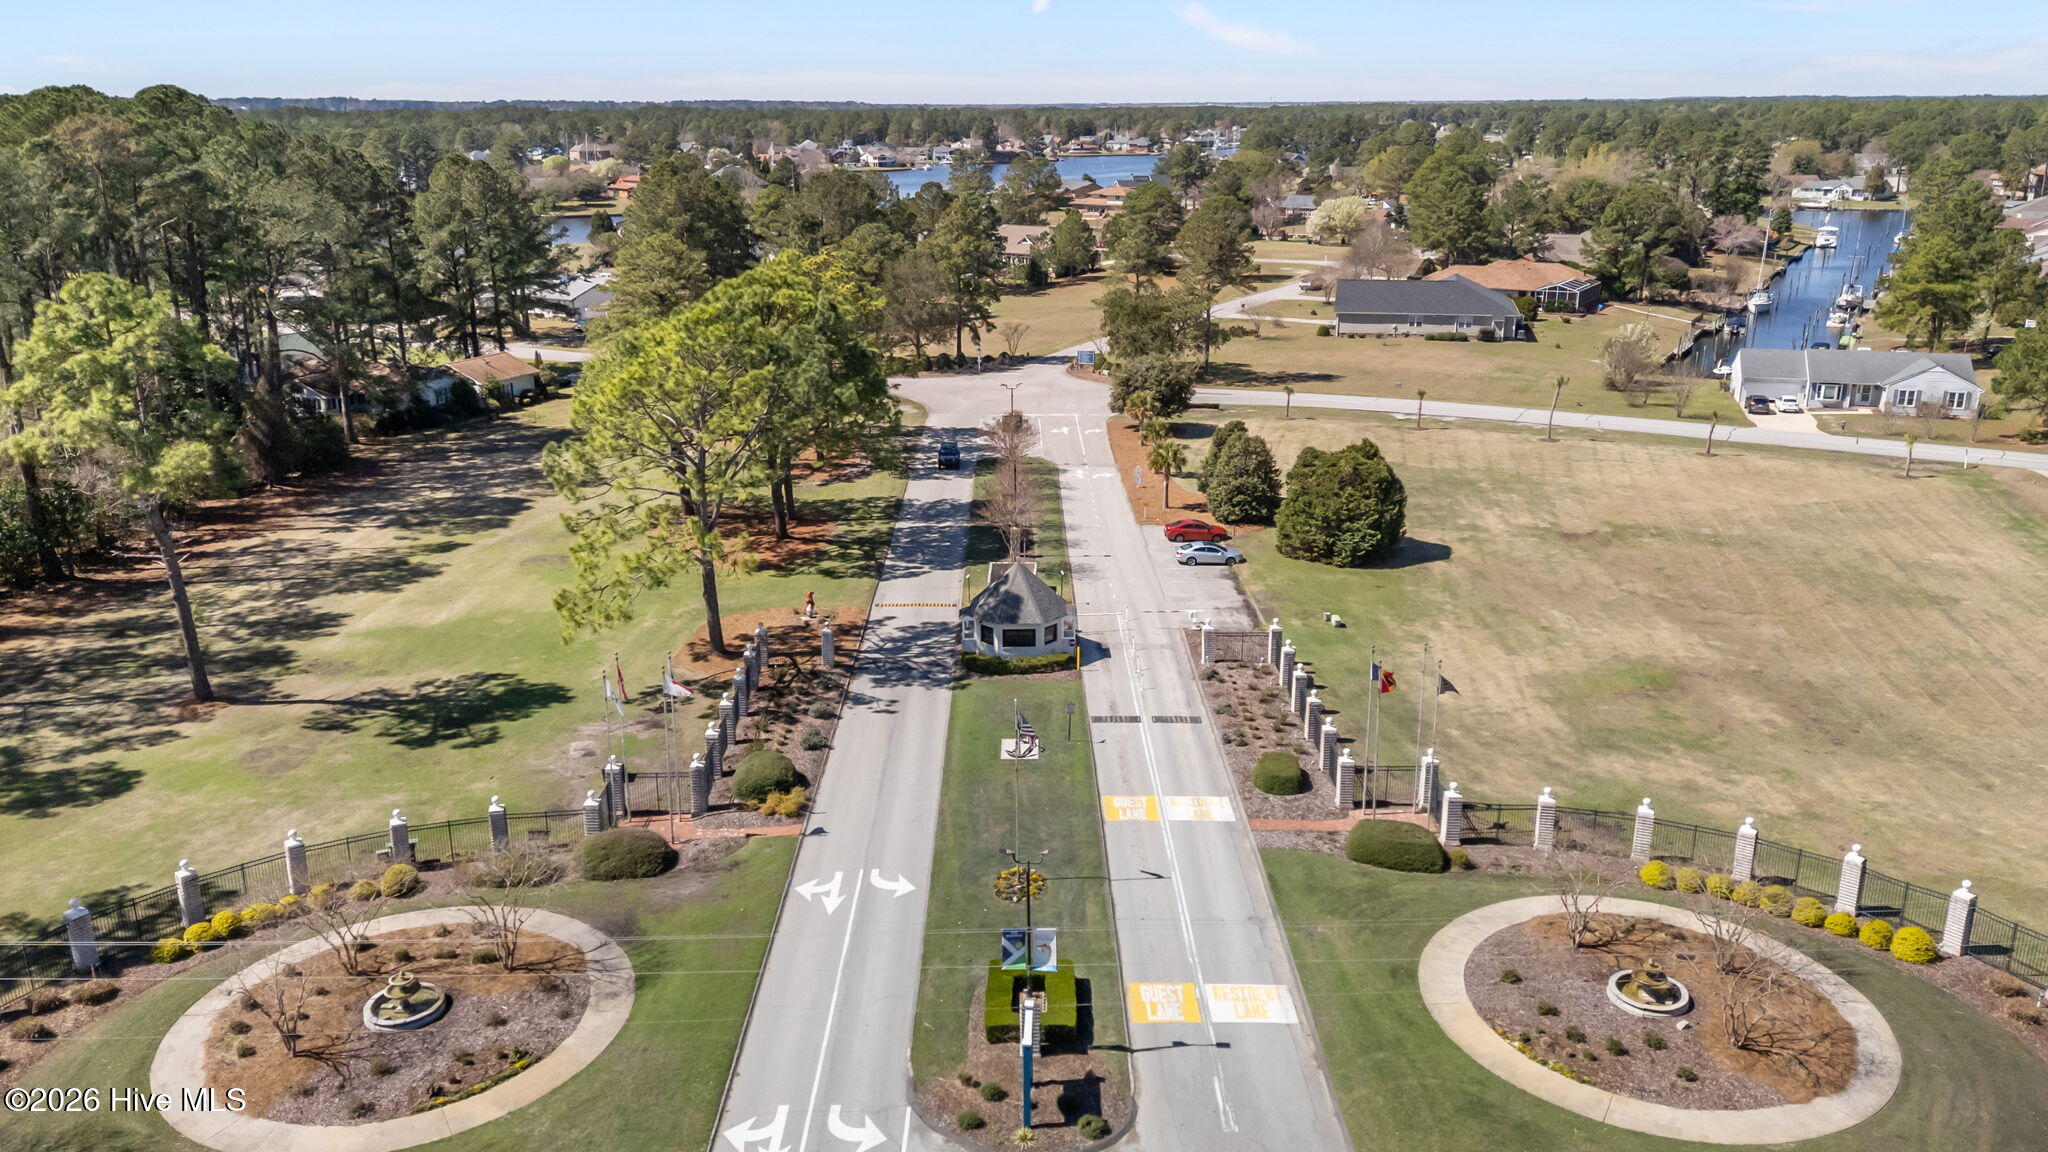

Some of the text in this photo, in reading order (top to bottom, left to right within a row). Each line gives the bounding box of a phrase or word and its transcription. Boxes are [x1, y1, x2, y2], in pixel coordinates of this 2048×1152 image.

[1113, 796, 1148, 808] GUEST
[1118, 808, 1148, 820] LANE
[1139, 985, 1183, 1002] GUEST
[1212, 986, 1284, 1002] RESIDENT
[1146, 1001, 1185, 1020] LANE
[1233, 1001, 1269, 1019] LANE
